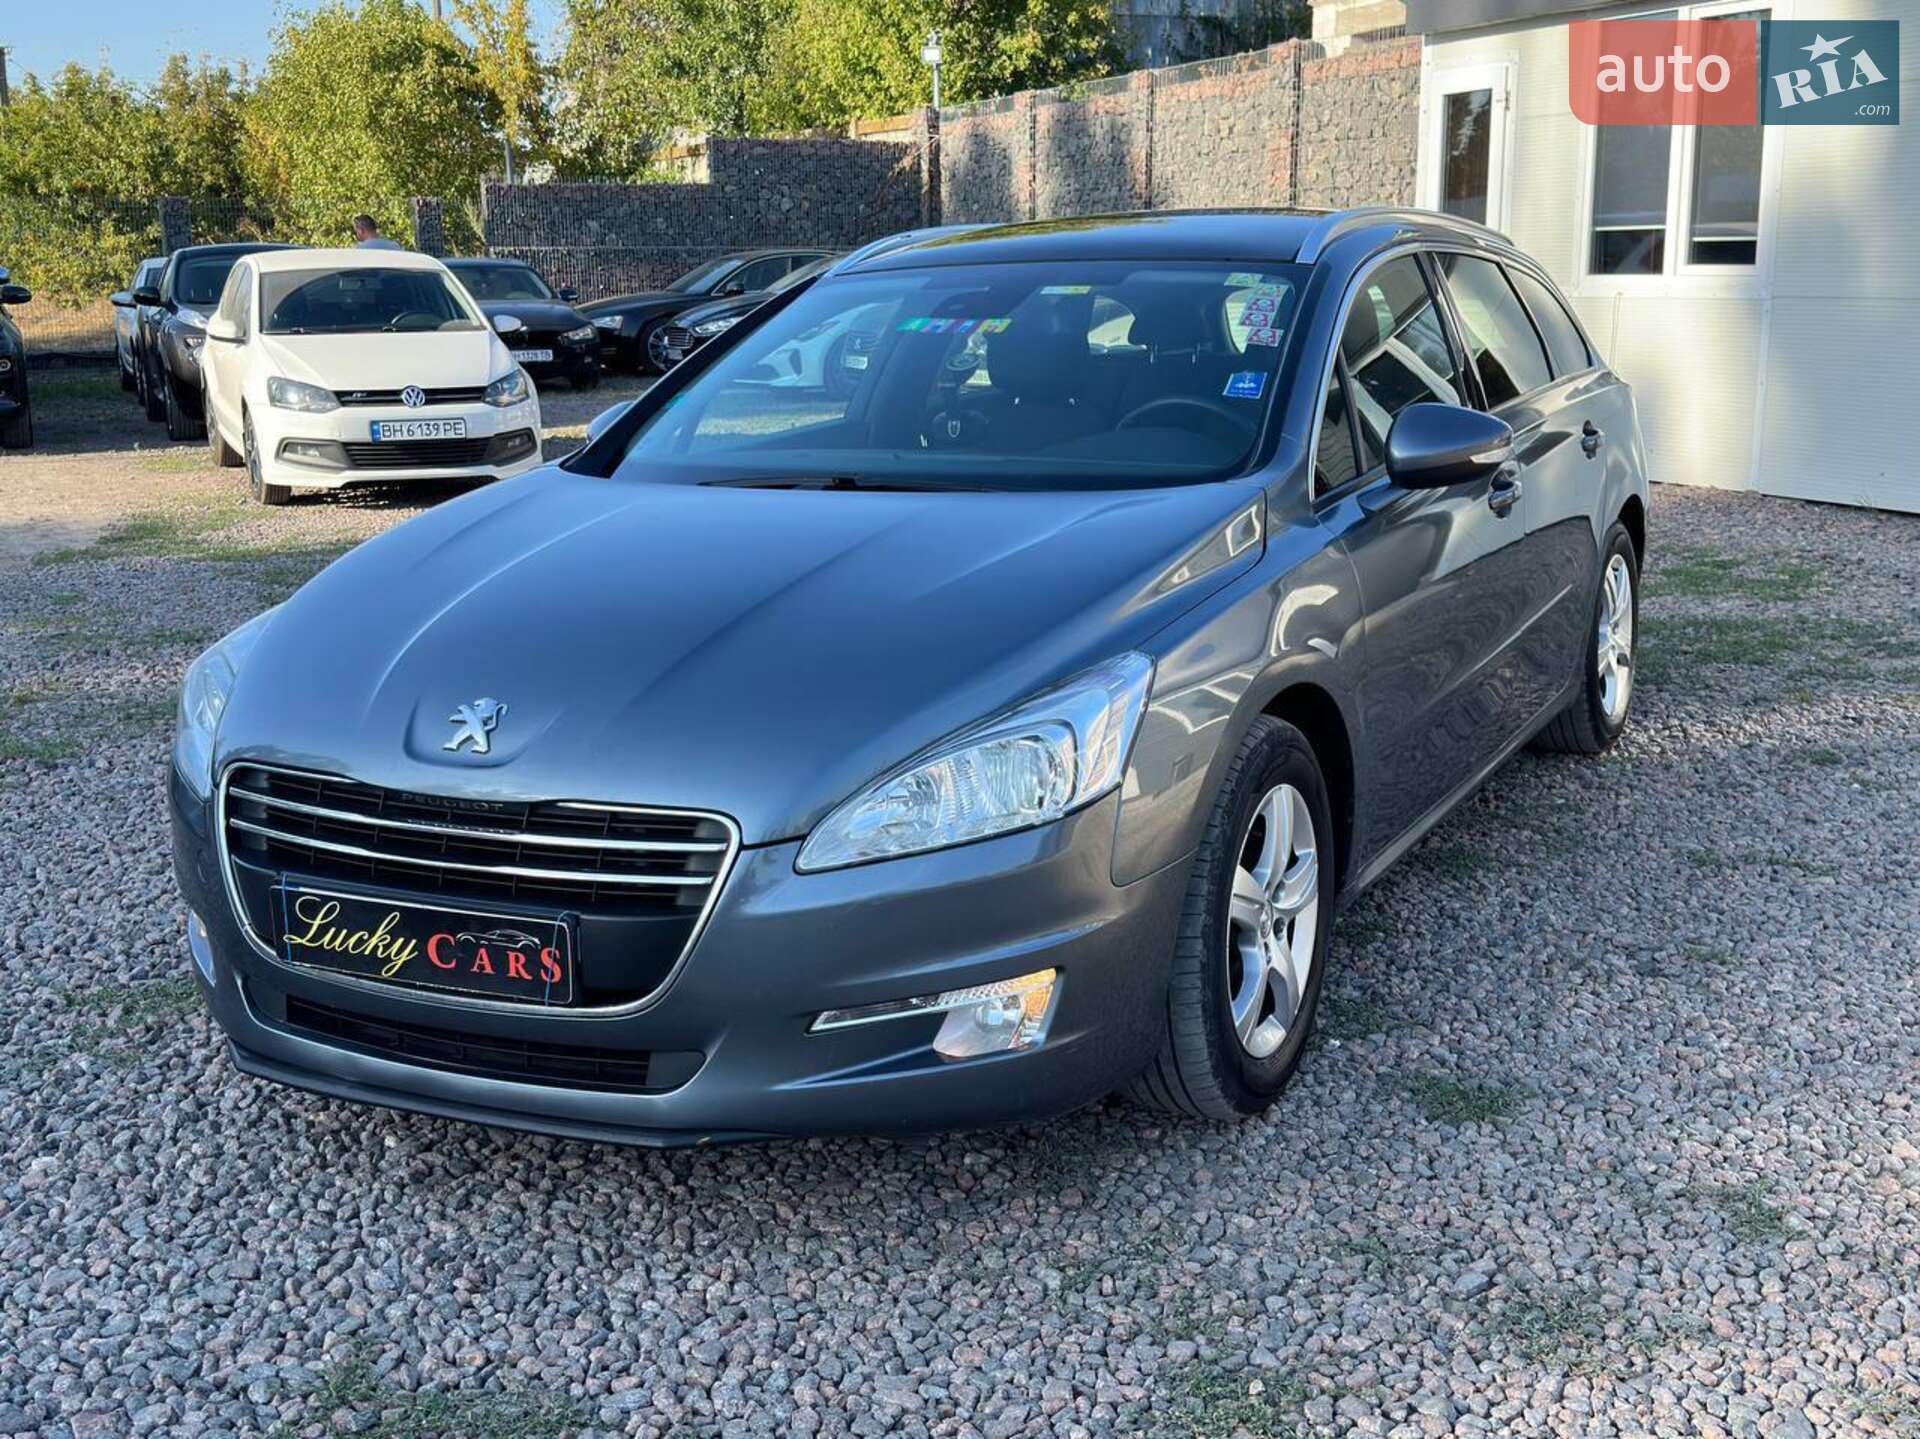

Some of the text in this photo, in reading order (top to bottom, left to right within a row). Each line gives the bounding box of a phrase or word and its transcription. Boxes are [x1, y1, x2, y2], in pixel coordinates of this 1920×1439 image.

[381, 421, 463, 438] BH 6139 PE
[283, 896, 562, 984] Lucky CARS
